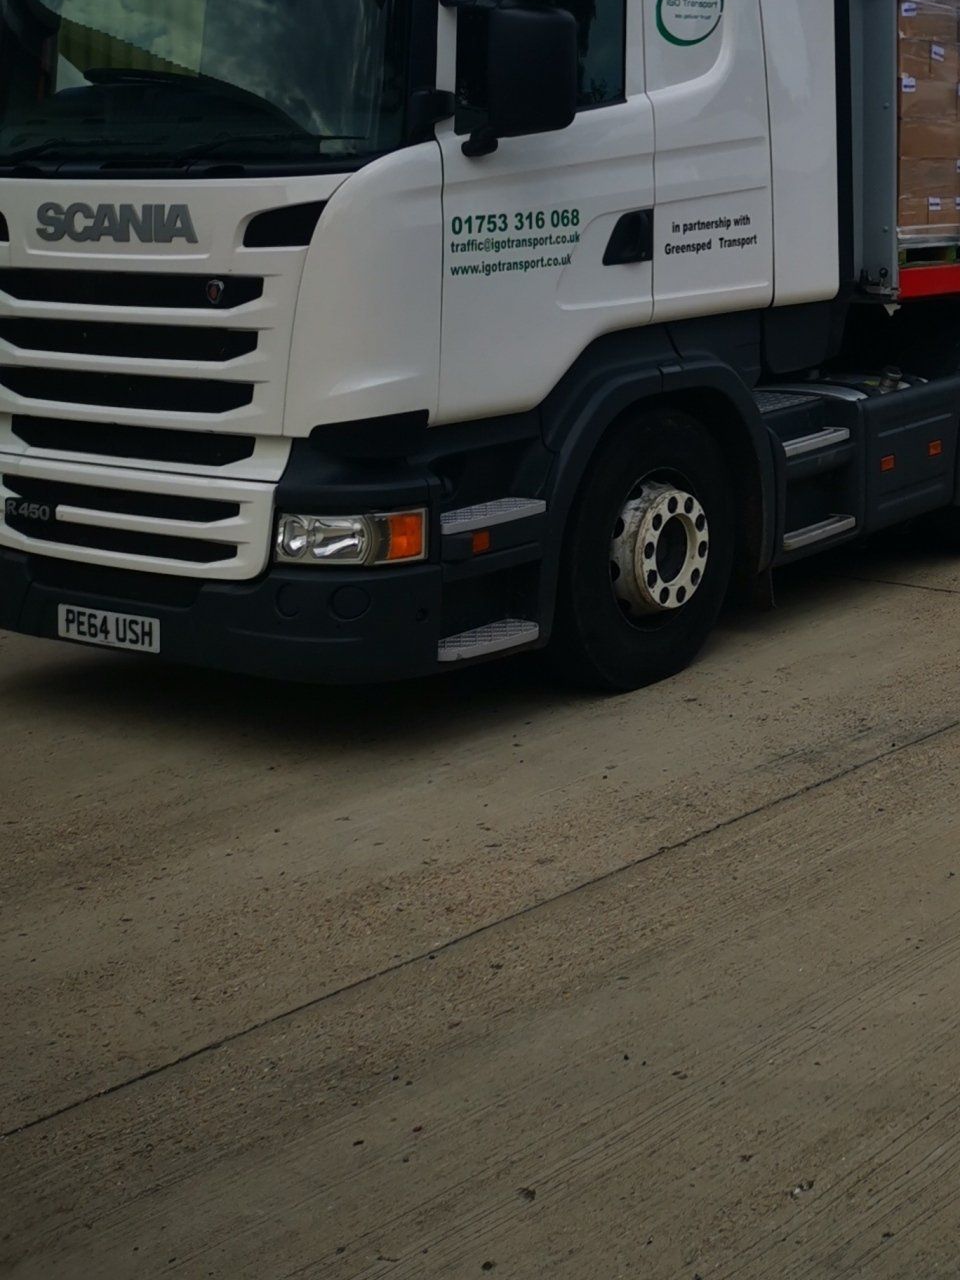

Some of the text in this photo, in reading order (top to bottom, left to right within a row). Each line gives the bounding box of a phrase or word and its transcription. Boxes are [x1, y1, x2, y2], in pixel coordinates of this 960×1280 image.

[36, 201, 199, 243] SCANIA
[451, 208, 580, 236] 01753 316 068
[672, 213, 751, 235] in partnership with
[450, 231, 581, 253] traffic@igotransport.co.uk
[664, 234, 758, 255] Greensped Transport
[450, 253, 572, 276] www.igotransport.co.uk
[65, 608, 153, 648] PE64 USH
